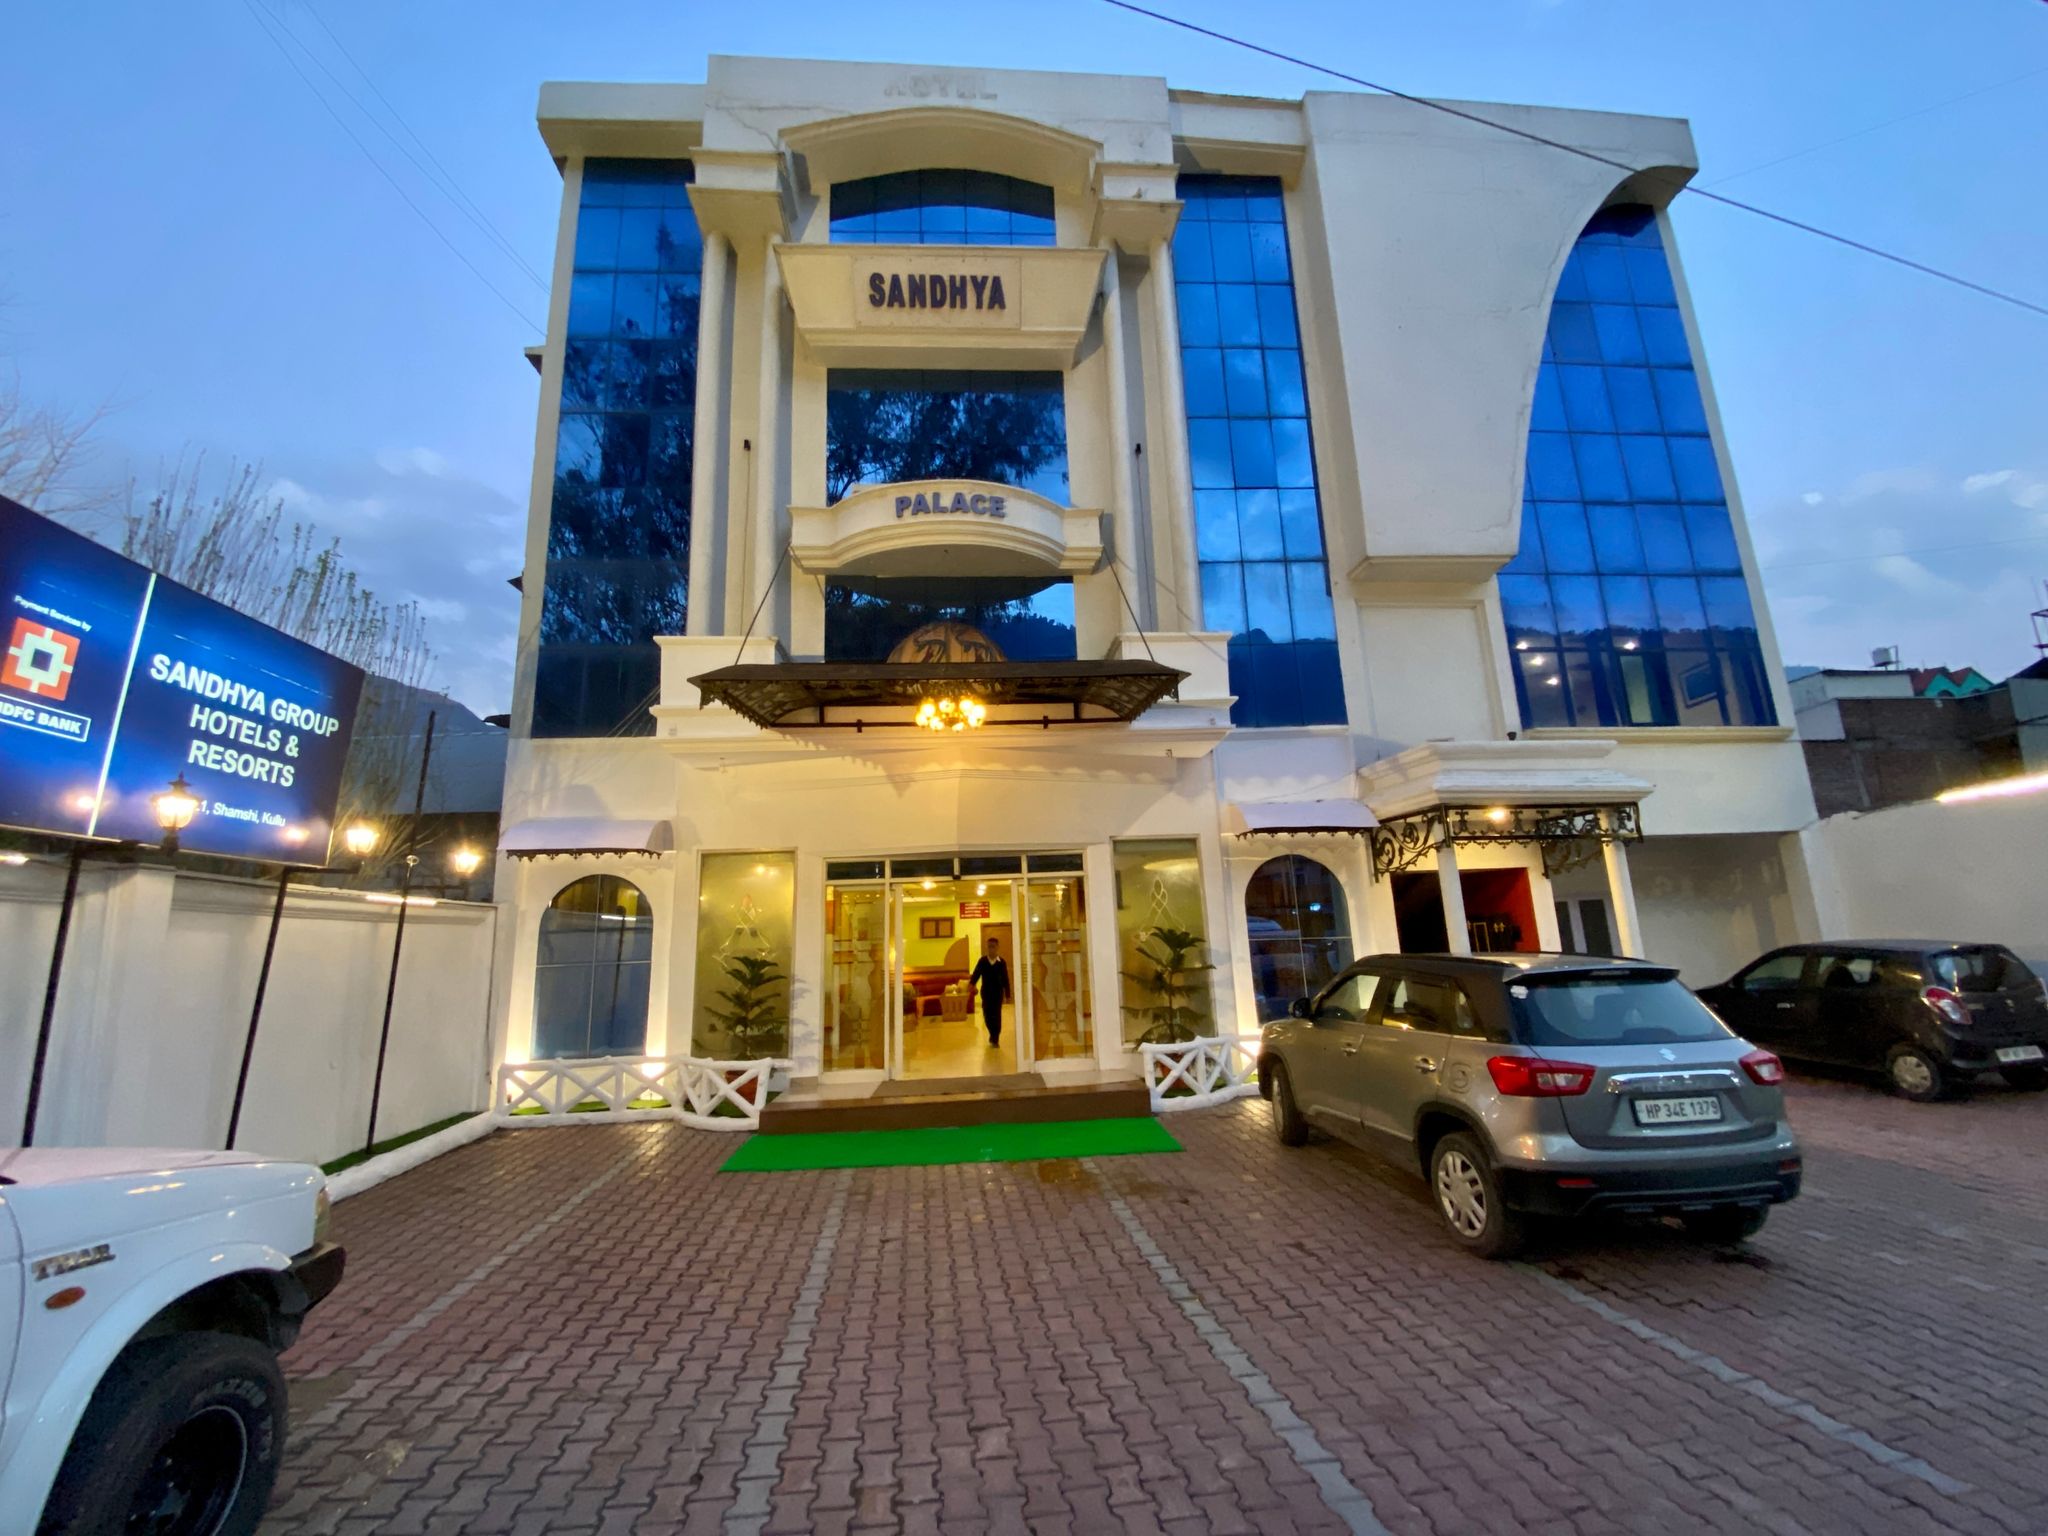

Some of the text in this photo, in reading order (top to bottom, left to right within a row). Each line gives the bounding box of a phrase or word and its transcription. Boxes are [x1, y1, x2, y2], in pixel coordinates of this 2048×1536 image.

[869, 272, 1006, 310] SANDHYA
[895, 491, 1006, 518] PALACE
[49, 608, 82, 628] Services
[150, 653, 339, 737] SANDHYA GROUP
[37, 712, 82, 734] BANK
[189, 704, 300, 758] HOTELS &
[187, 739, 295, 787] RESORTS
[261, 811, 286, 827] Kullu
[1644, 1099, 1719, 1119] HP 34E 1379
[31, 1243, 116, 1282] THAR
